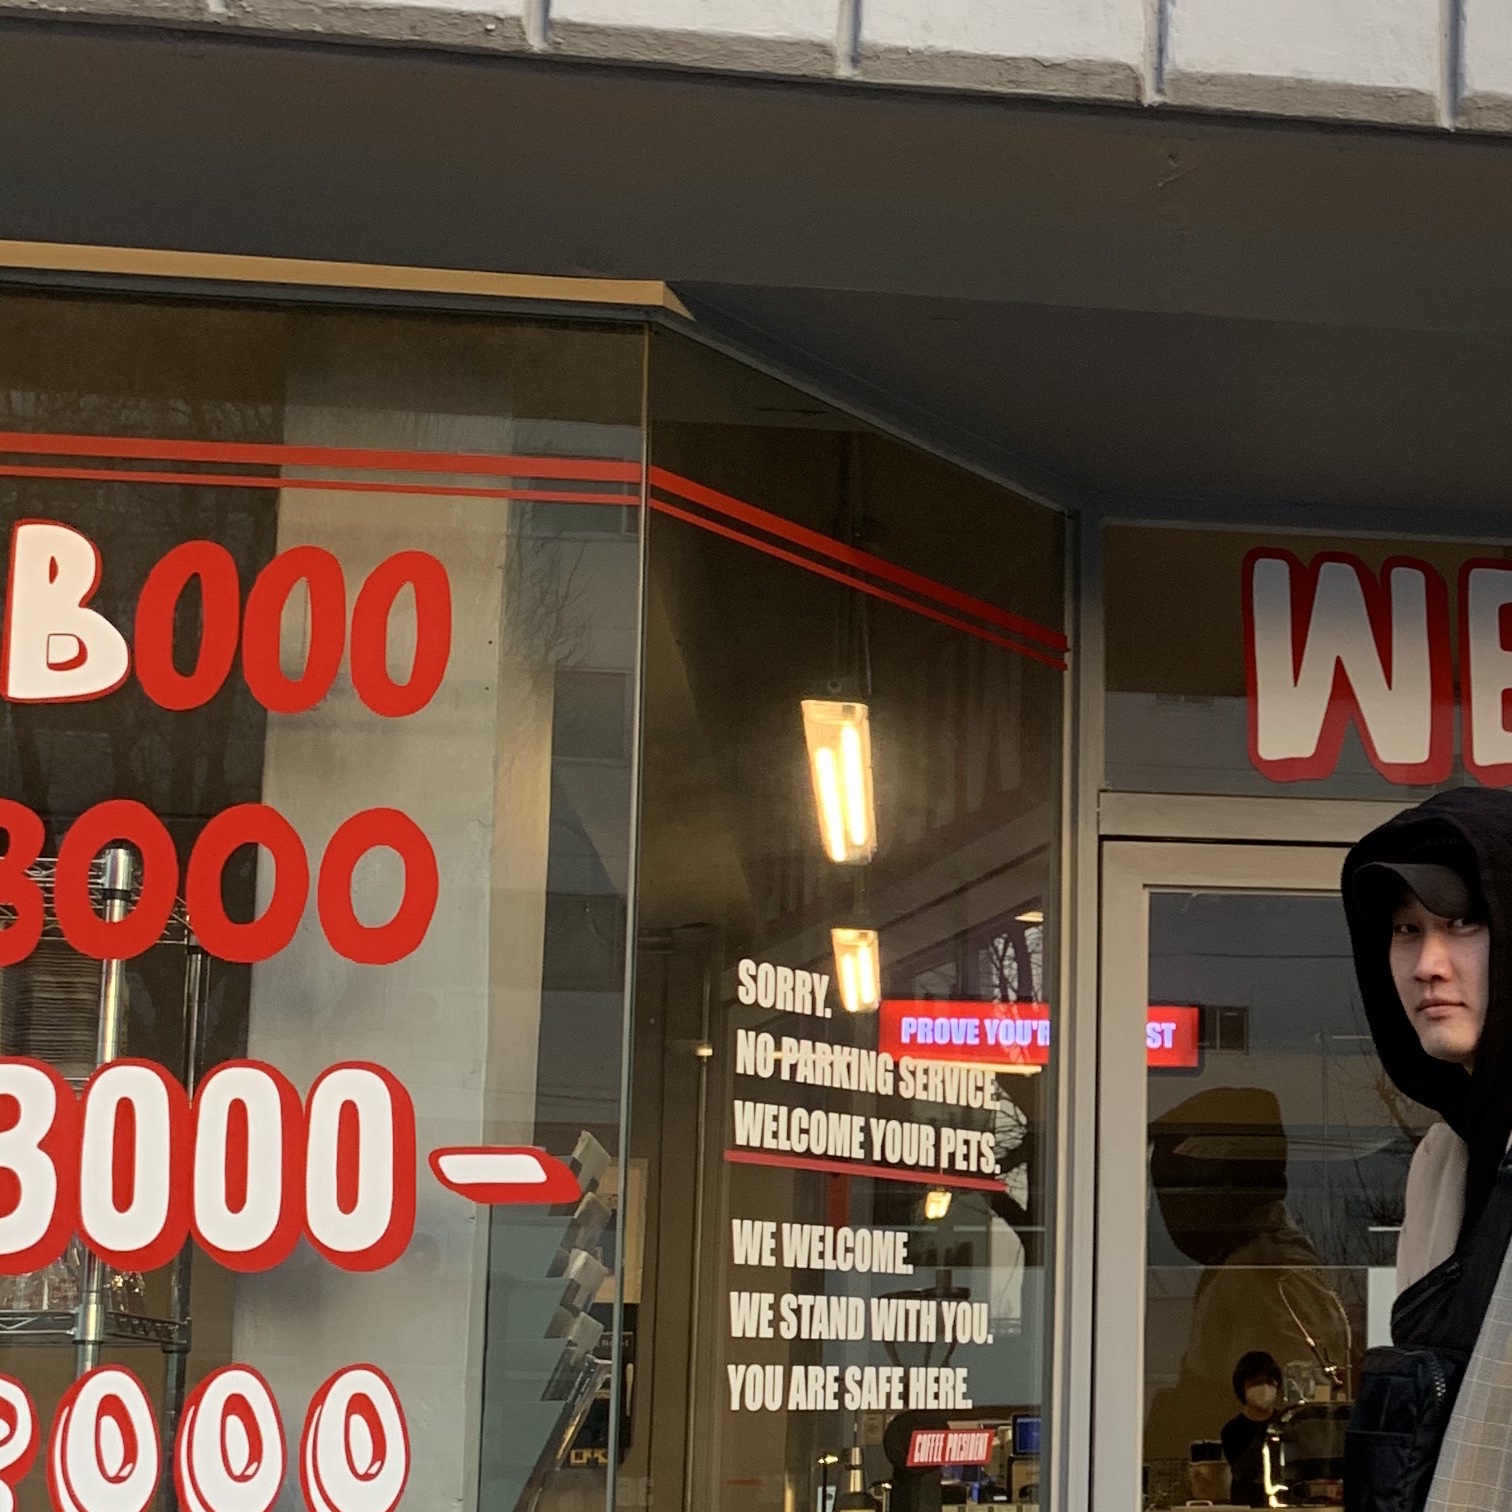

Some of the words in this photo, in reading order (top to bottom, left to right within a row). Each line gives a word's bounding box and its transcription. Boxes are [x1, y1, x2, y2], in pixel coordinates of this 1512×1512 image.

[738, 958, 832, 1018] SORRY.
[901, 1016, 979, 1046] PROVE
[736, 1029, 775, 1078] NO
[780, 1036, 894, 1096] PARKING
[734, 1099, 865, 1159] WELCOME
[870, 1117, 935, 1167] YOUR
[940, 1127, 1001, 1174] PETS.
[732, 1219, 776, 1267] WE
[782, 1222, 914, 1275] WELCOME.
[730, 1291, 775, 1338] WE
[779, 1293, 865, 1340] STAND
[870, 1298, 938, 1343] WITH
[941, 1301, 994, 1345] YOU.
[727, 1364, 784, 1411] YOU
[788, 1365, 840, 1411] ARE
[844, 1365, 904, 1411] SAFE
[908, 1366, 973, 1410] HERE.
